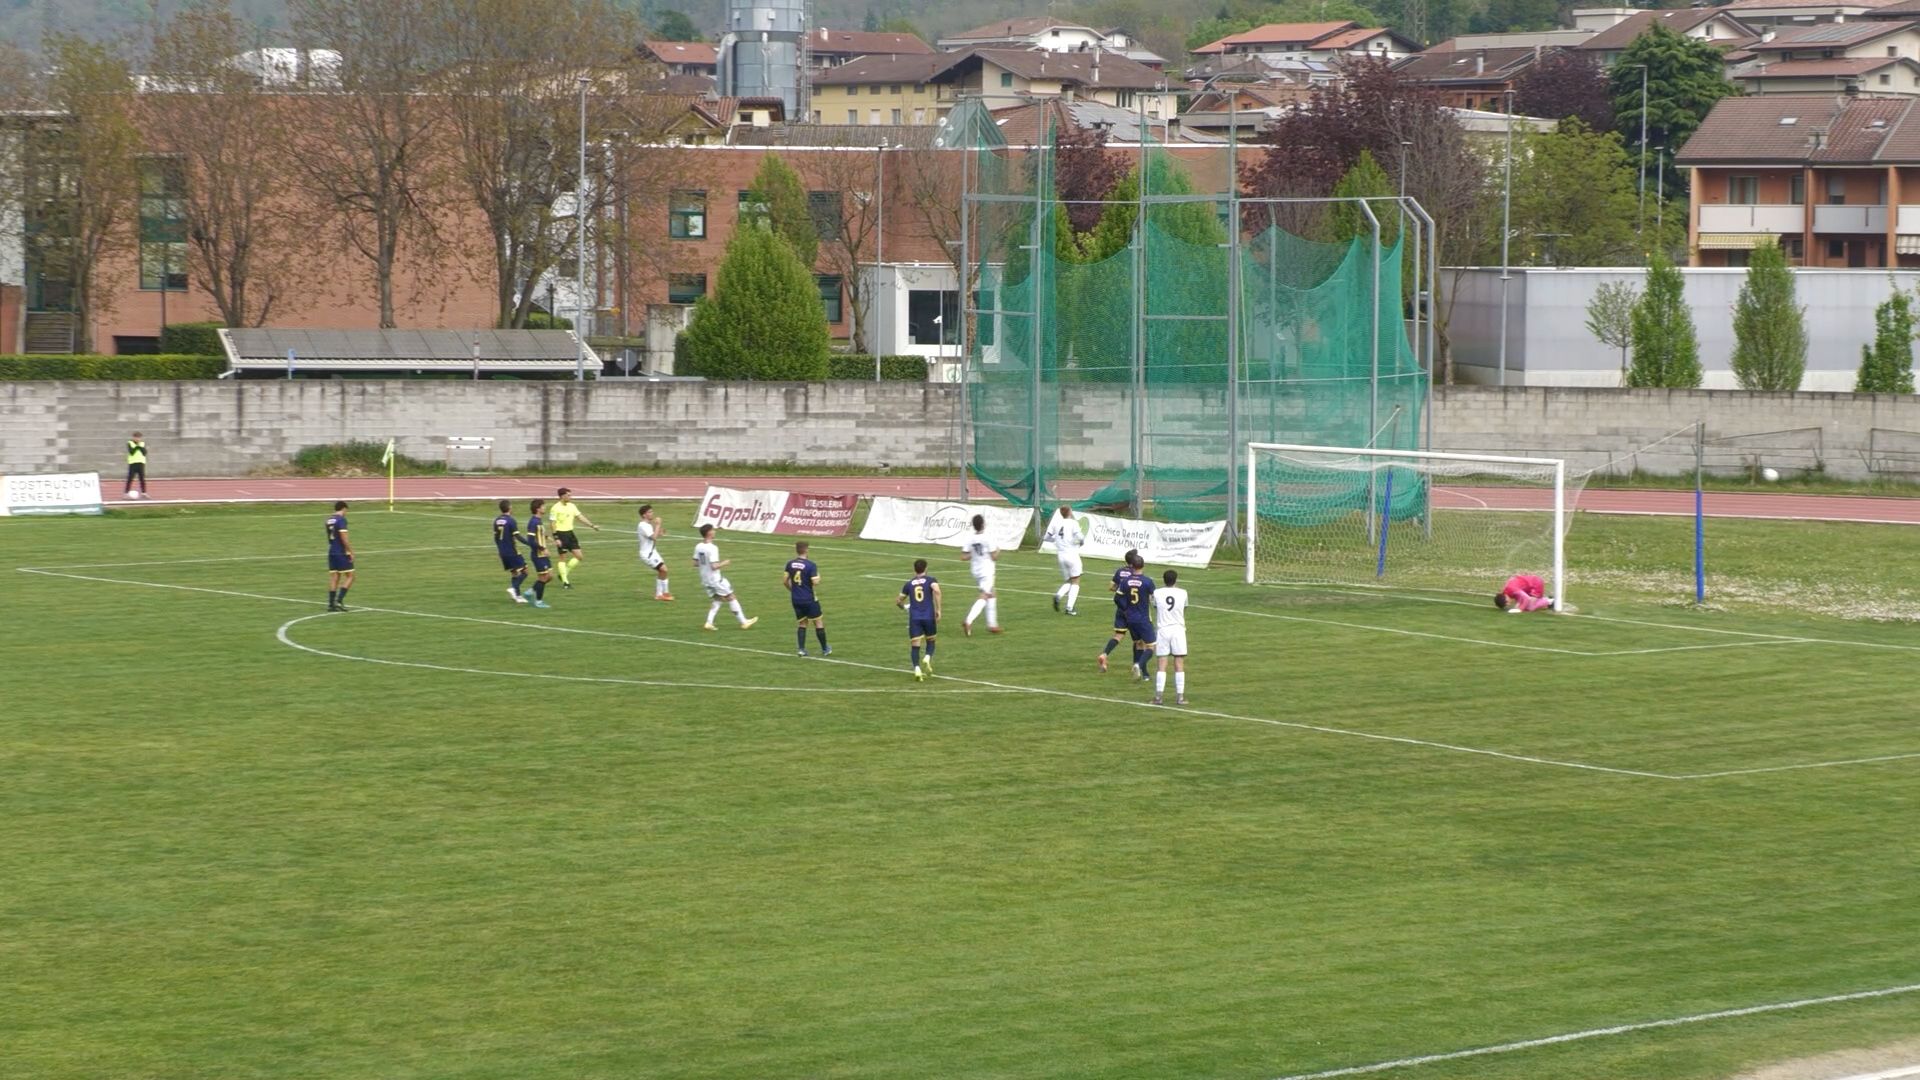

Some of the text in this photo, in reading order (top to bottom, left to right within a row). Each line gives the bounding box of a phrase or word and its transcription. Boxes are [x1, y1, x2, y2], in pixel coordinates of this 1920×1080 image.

[10, 479, 96, 490] COSTRUZIONI
[781, 515, 816, 527] PRODOTTI
[497, 525, 504, 540] 7
[793, 570, 802, 586] 4
[914, 585, 924, 602] 6
[1130, 587, 1139, 604] 5
[1165, 596, 1175, 612] 9
